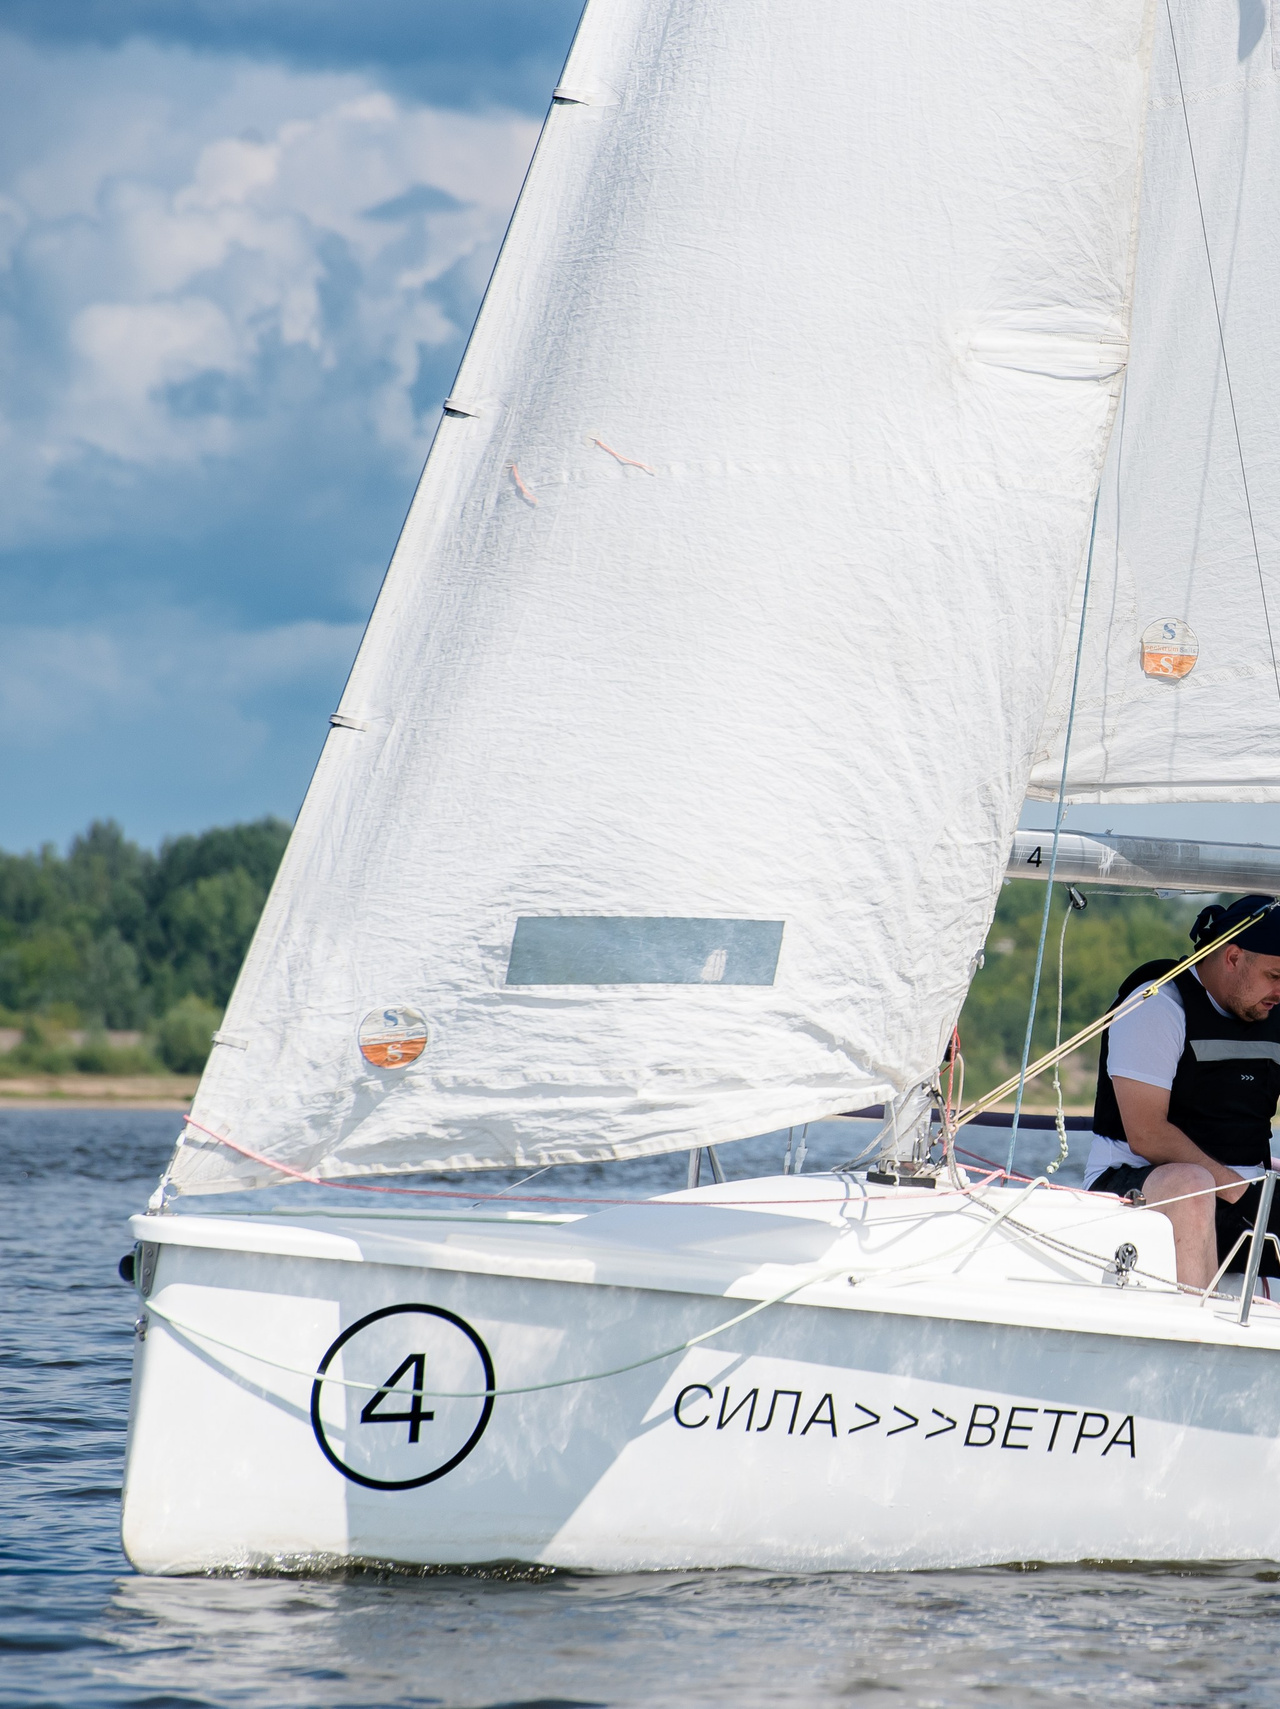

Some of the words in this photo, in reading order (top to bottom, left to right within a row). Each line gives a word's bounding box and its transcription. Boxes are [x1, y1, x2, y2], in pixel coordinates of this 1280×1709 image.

[1162, 622, 1177, 640] S
[1160, 656, 1174, 674] S
[1026, 846, 1043, 868] 4
[383, 1009, 398, 1027] S
[360, 1353, 435, 1444] 4
